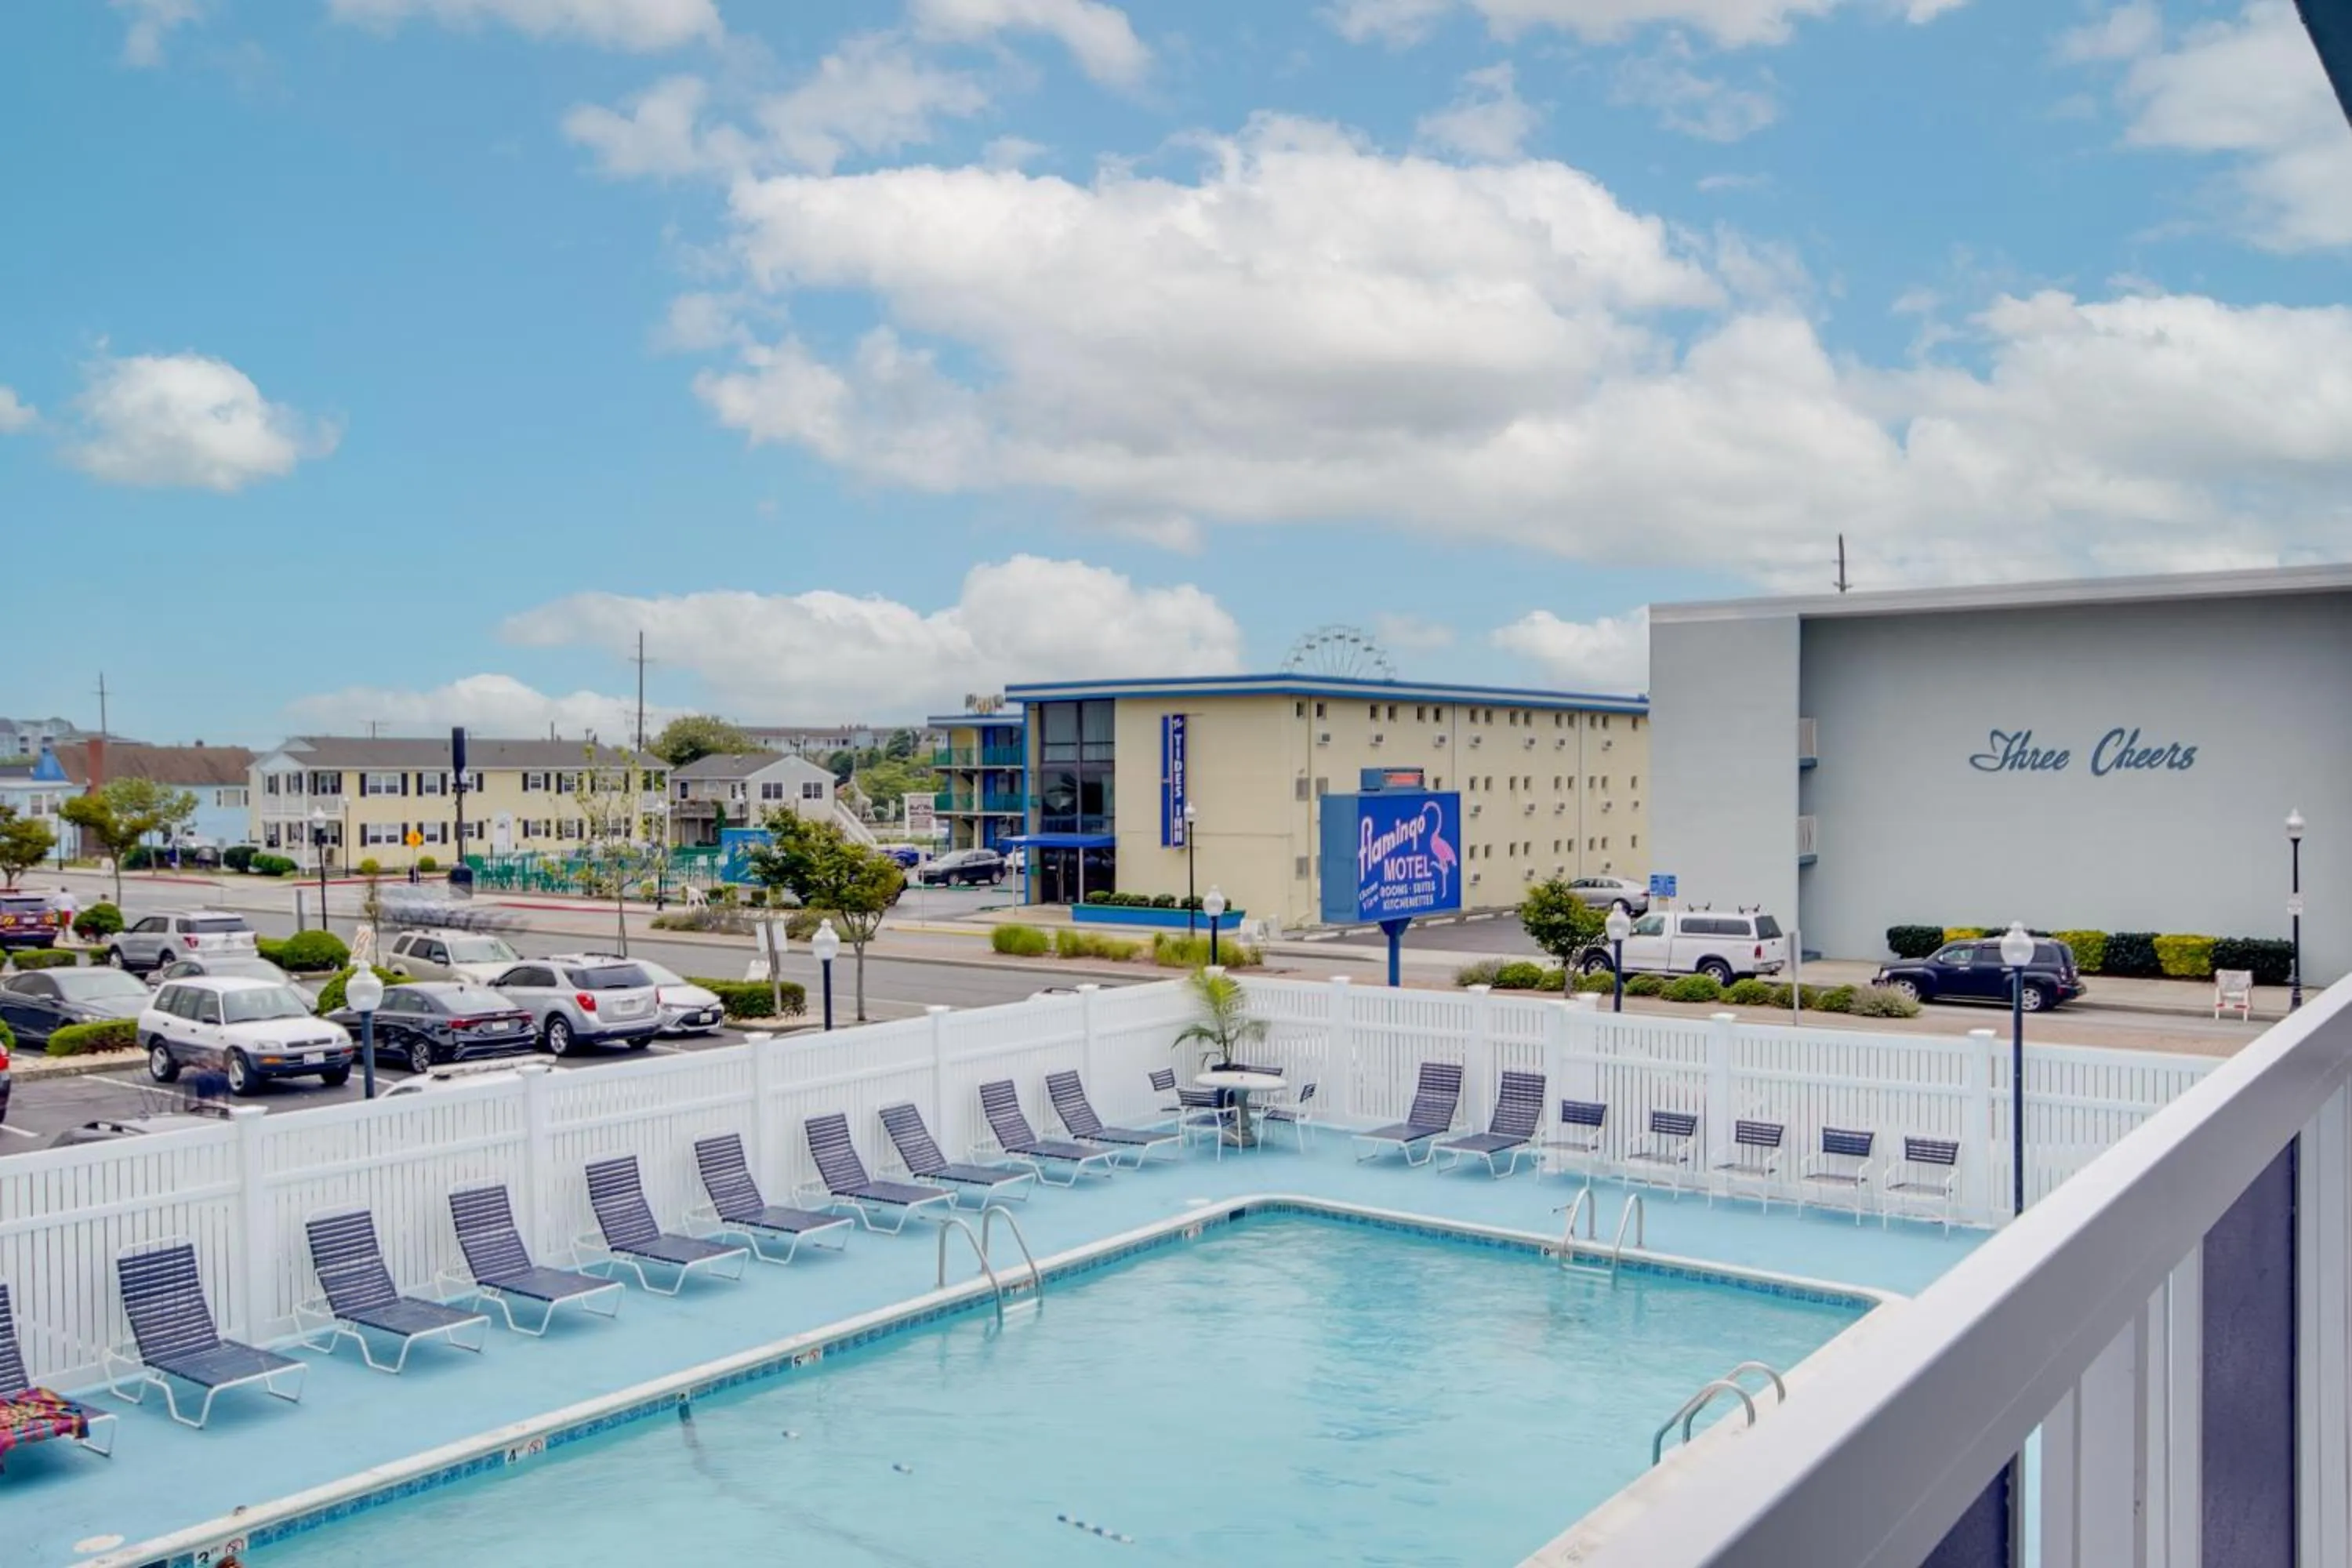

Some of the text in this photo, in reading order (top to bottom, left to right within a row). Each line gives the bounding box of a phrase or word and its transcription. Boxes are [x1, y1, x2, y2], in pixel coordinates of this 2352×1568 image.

[1969, 728, 2199, 777] Three Cheers
[1174, 733, 1183, 844] TIDES INN
[1384, 855, 1432, 882] MOTEL
[1380, 880, 1436, 898] ROOMS SUITES
